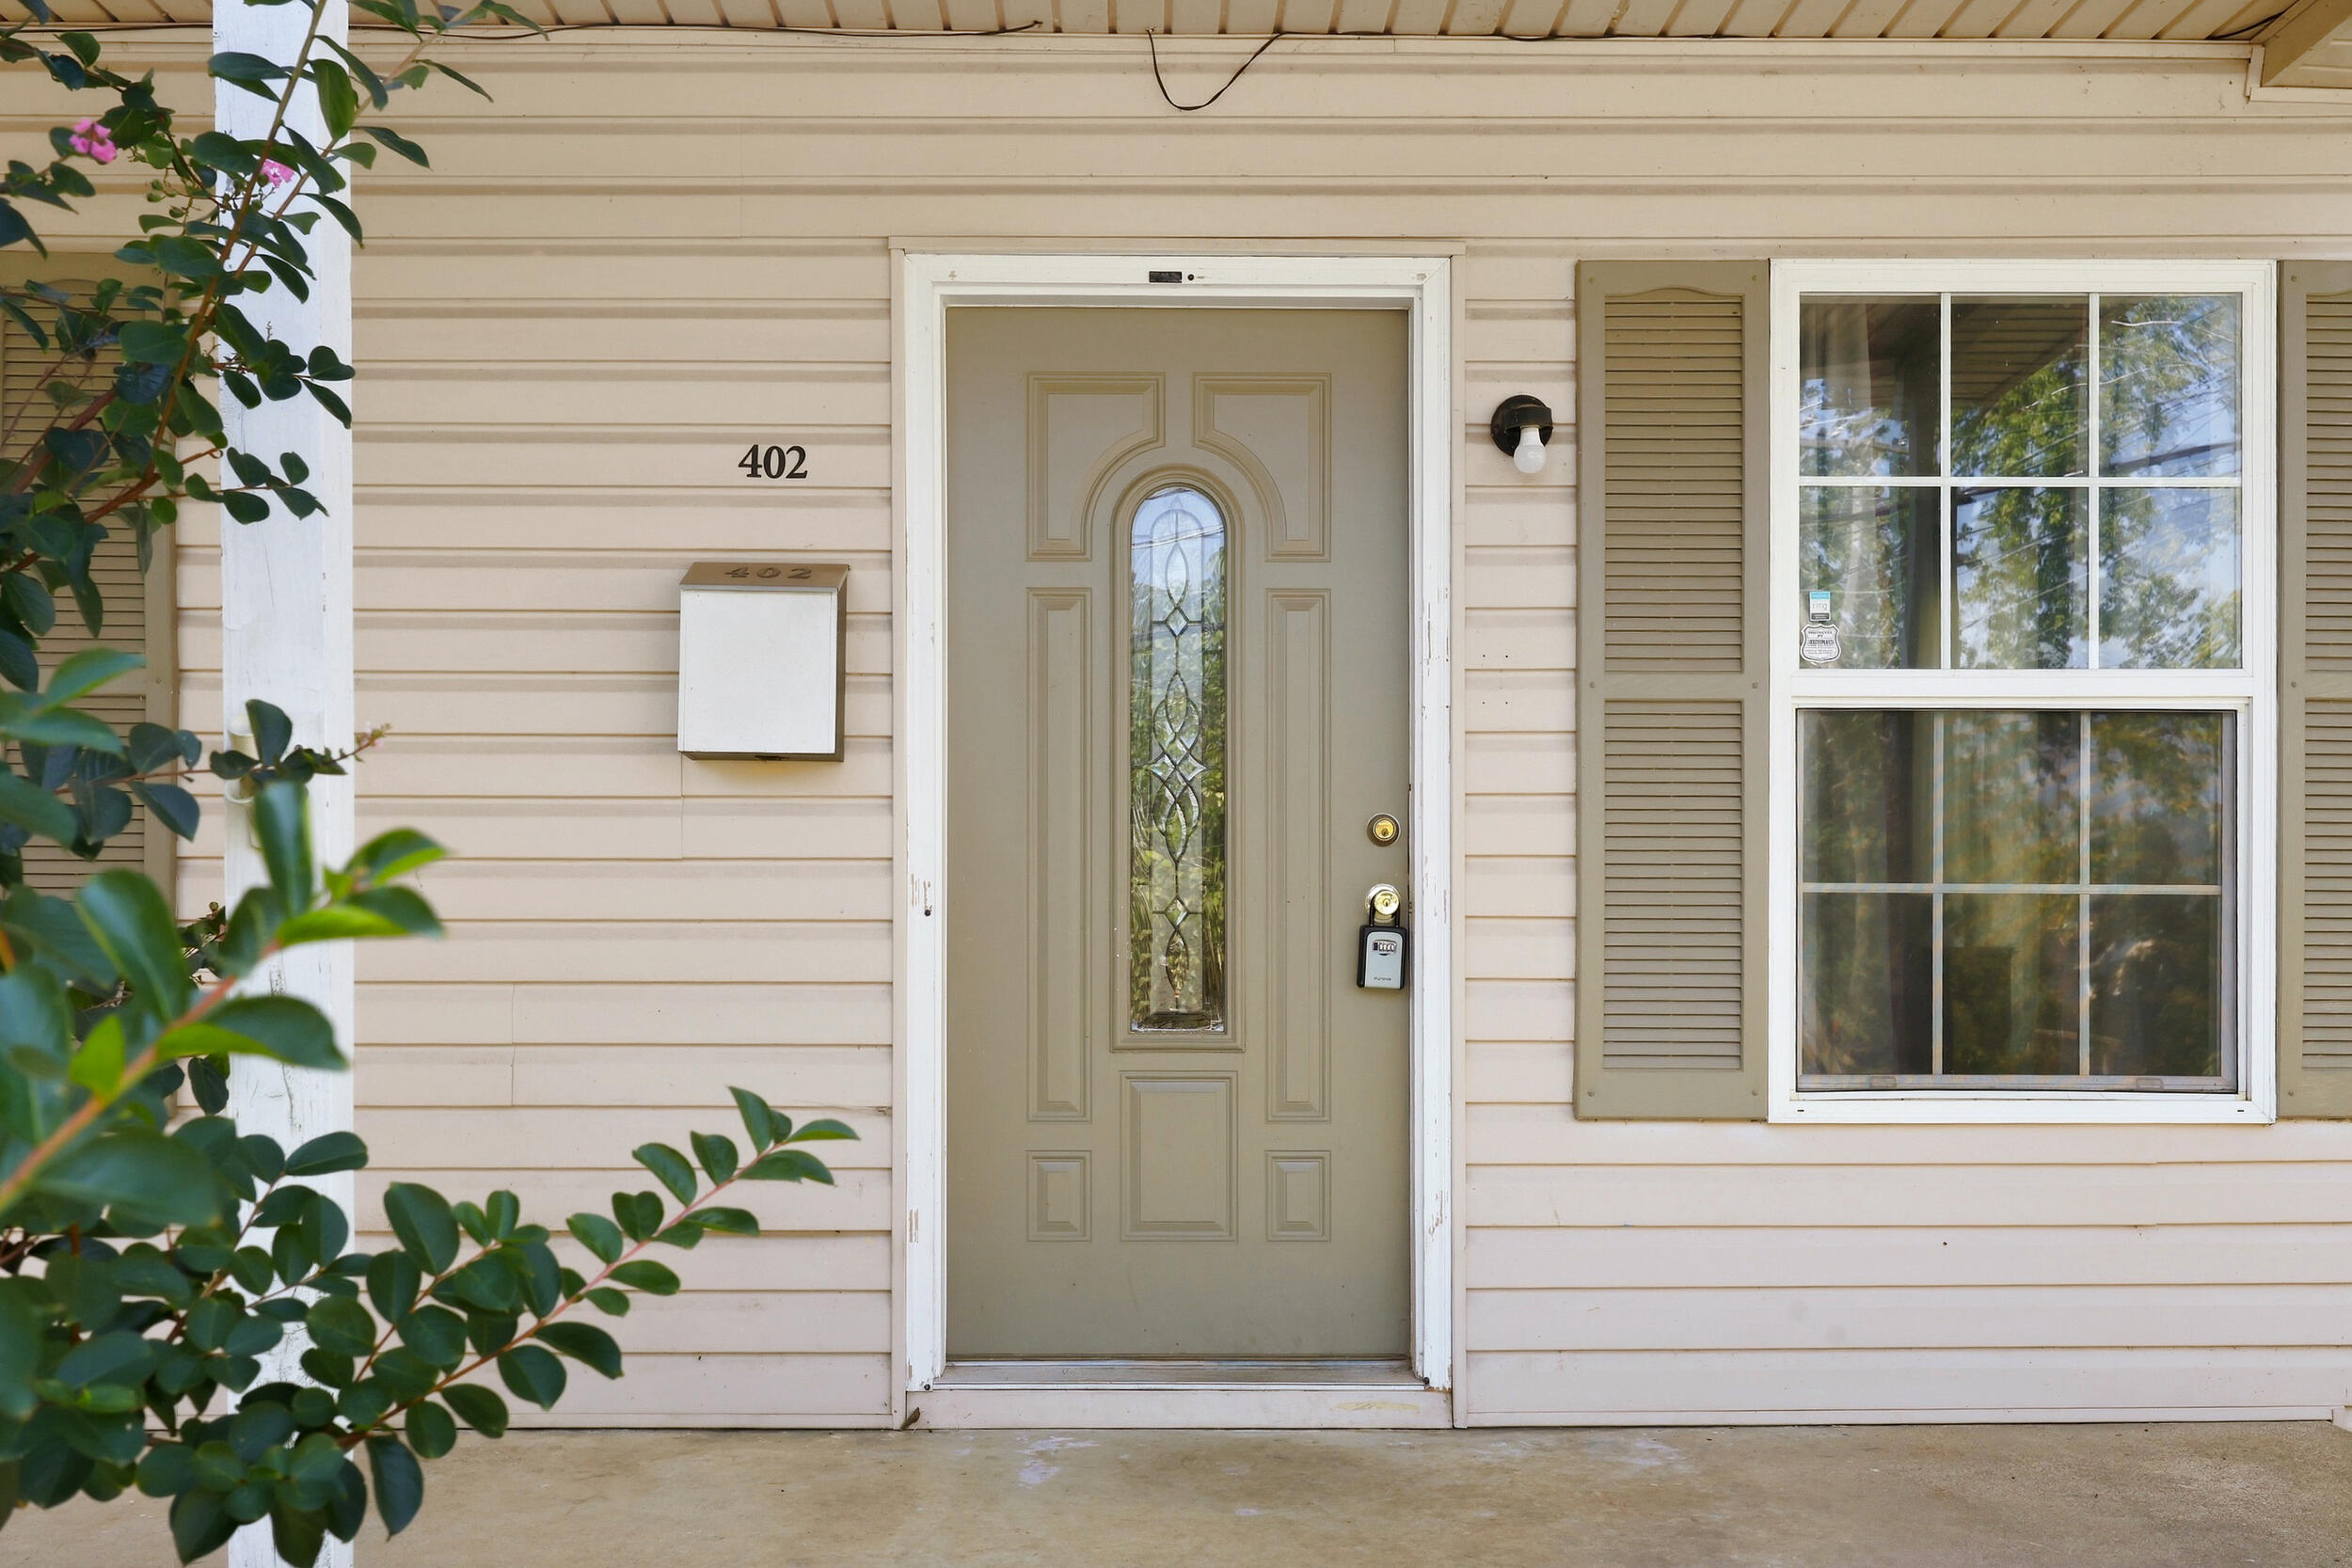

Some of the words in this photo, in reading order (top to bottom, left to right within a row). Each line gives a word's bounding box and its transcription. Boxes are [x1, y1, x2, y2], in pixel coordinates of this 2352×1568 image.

[738, 444, 809, 479] 402
[724, 566, 813, 579] 402
[1812, 601, 1828, 611] ring
